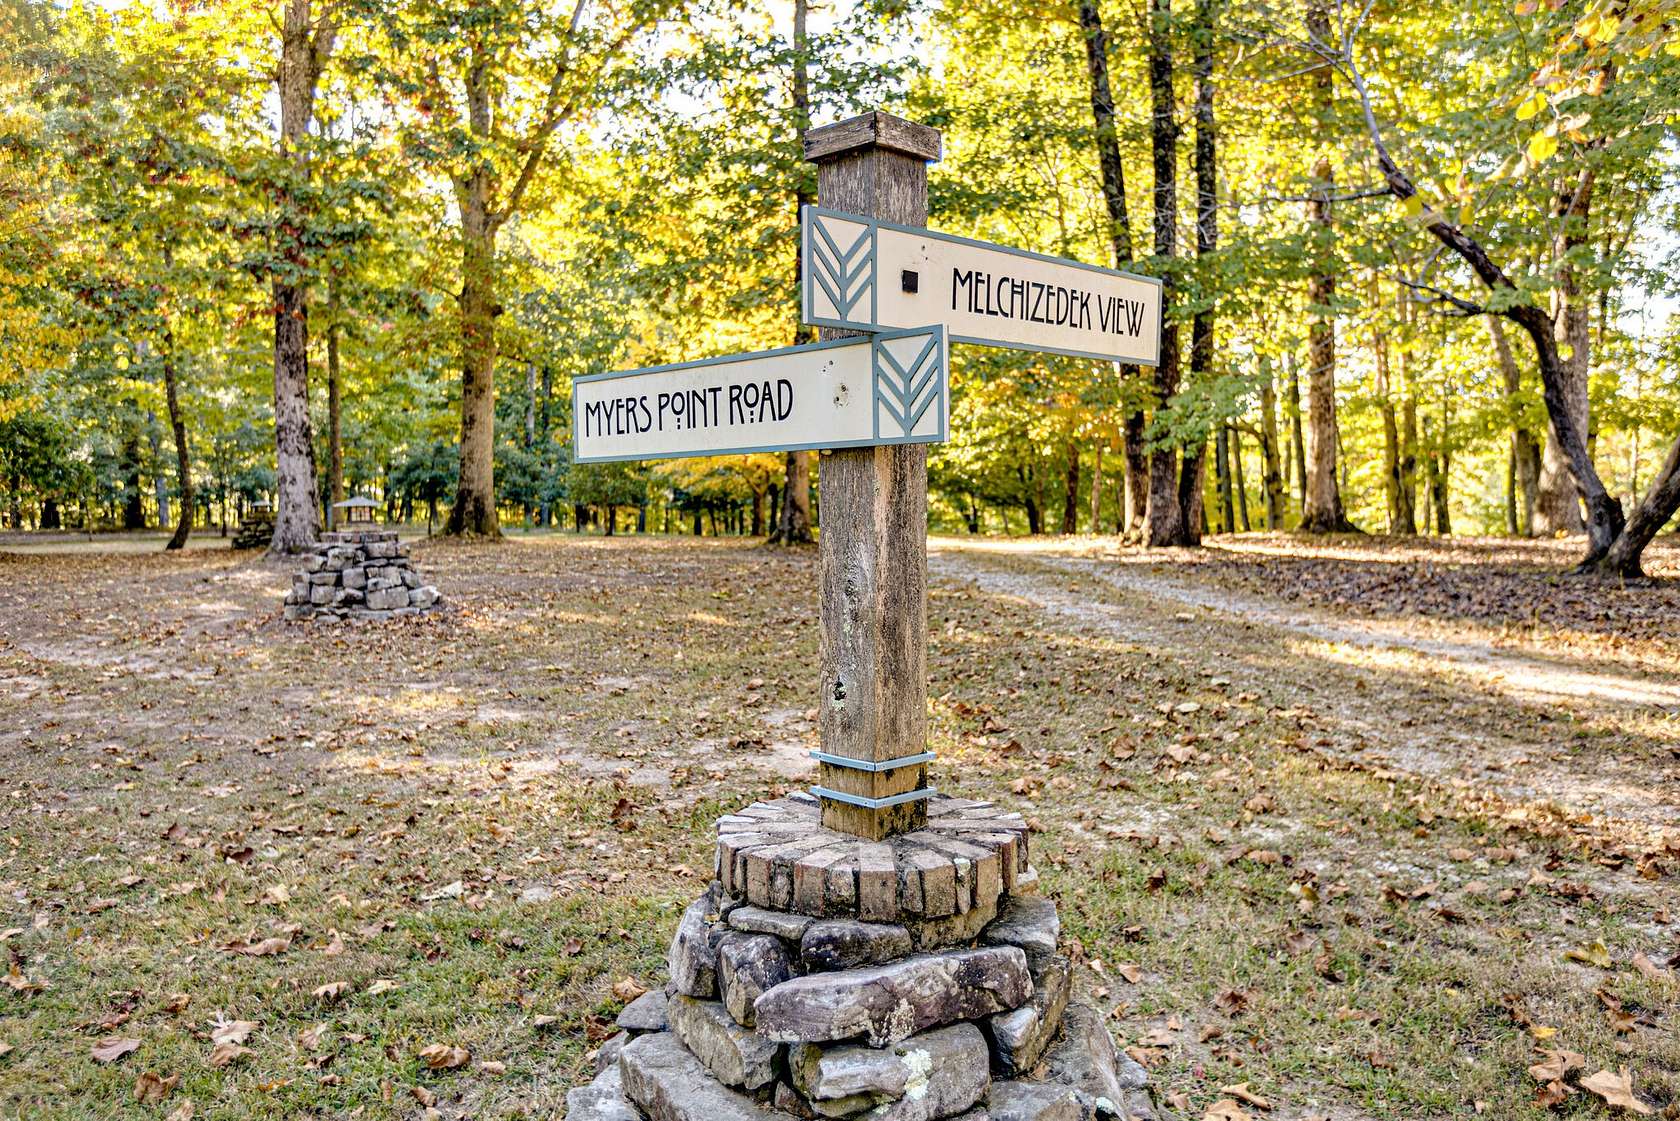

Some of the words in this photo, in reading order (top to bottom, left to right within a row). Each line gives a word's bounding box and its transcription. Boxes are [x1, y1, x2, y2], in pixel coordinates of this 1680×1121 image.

[952, 267, 1091, 330] MELCHIZEDEK
[1098, 294, 1145, 337] VIEW
[585, 396, 652, 437] MYERS
[658, 387, 722, 431] POINT
[729, 379, 793, 426] ROAD
